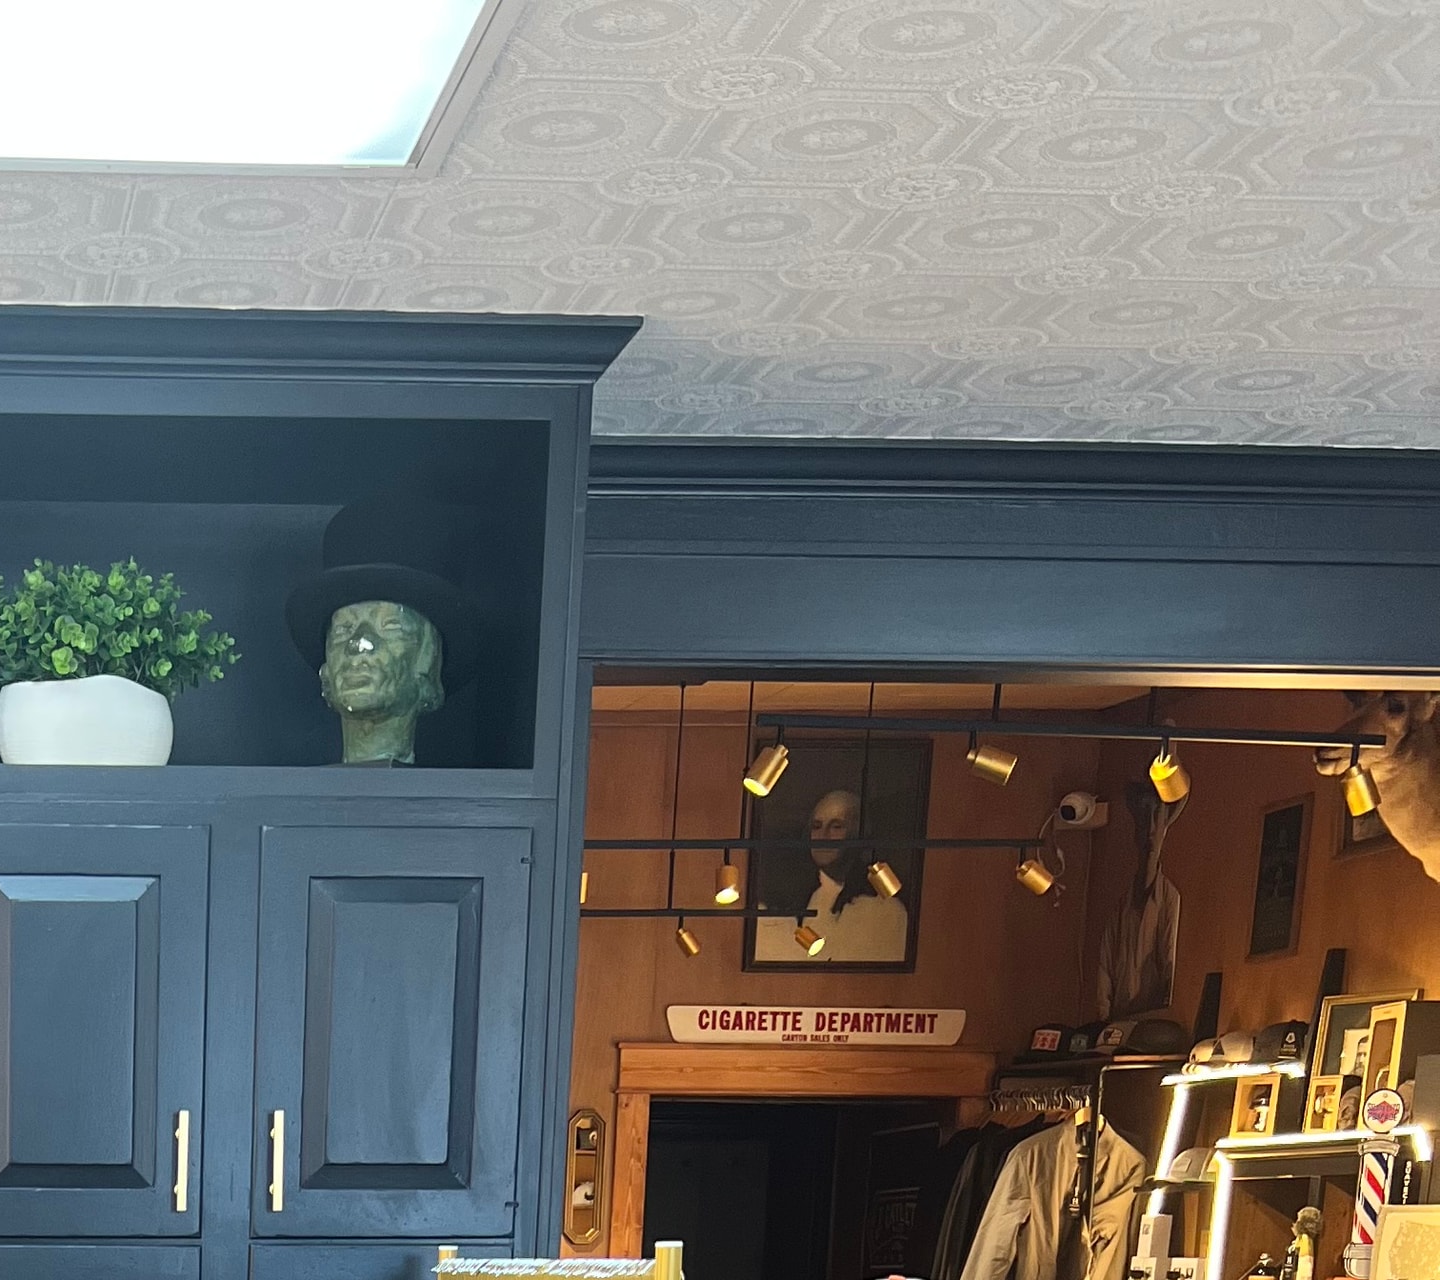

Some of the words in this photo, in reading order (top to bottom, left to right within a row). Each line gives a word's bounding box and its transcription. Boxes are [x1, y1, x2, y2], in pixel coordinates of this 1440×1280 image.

[698, 1010, 803, 1031] CIGARETTE
[815, 1012, 938, 1033] DEPARTMENT
[833, 1035, 848, 1043] ONLY
